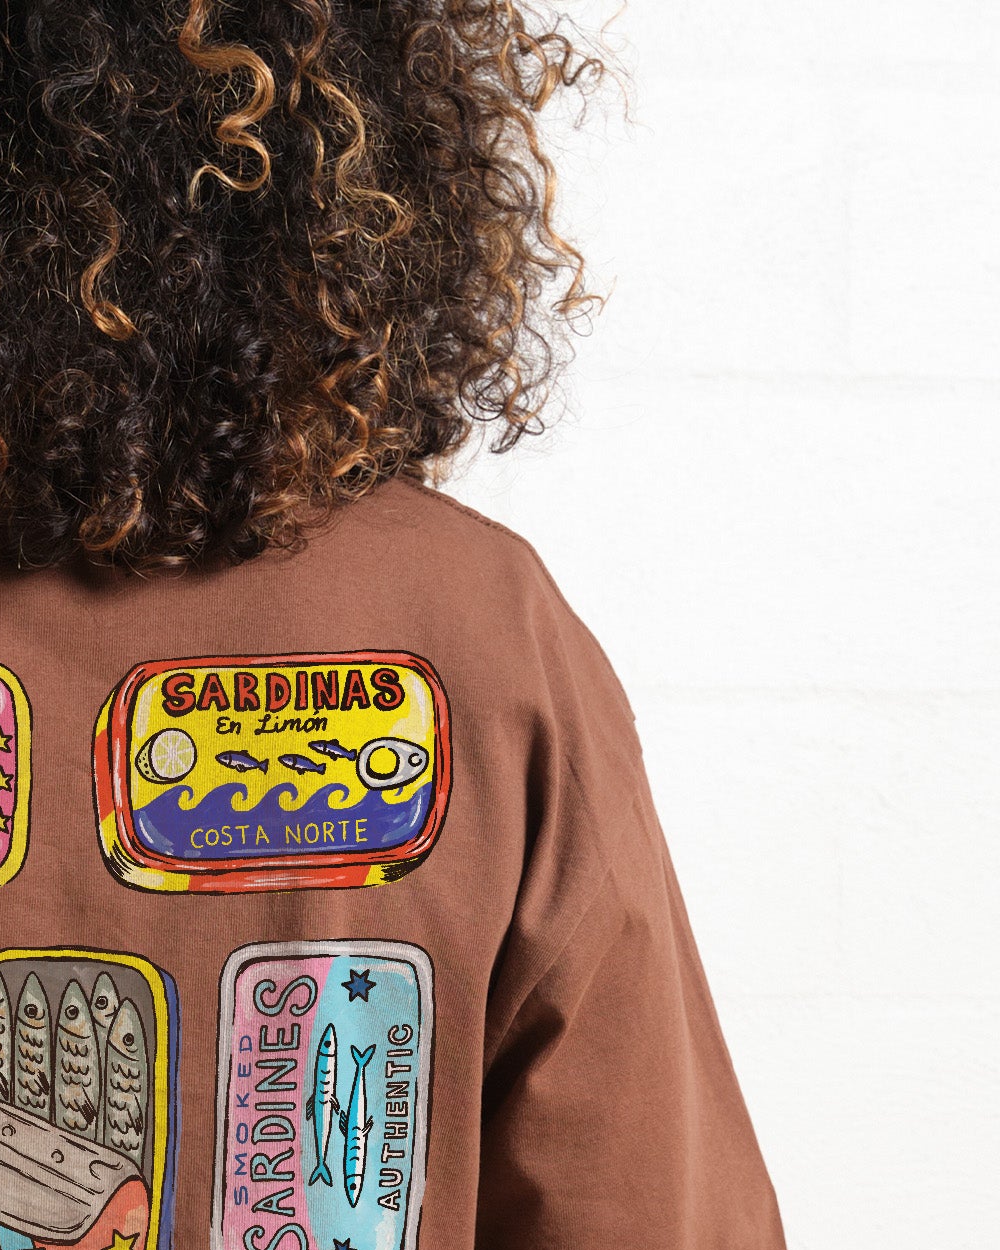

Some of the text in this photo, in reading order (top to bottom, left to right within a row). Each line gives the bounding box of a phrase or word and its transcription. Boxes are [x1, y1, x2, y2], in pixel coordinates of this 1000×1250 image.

[161, 668, 406, 716] SARDINAS
[215, 711, 328, 735] En Limón
[190, 818, 368, 849] COSTA NORTE
[233, 1034, 252, 1206] SMOKED
[377, 1023, 414, 1211] AUTHENTIC
